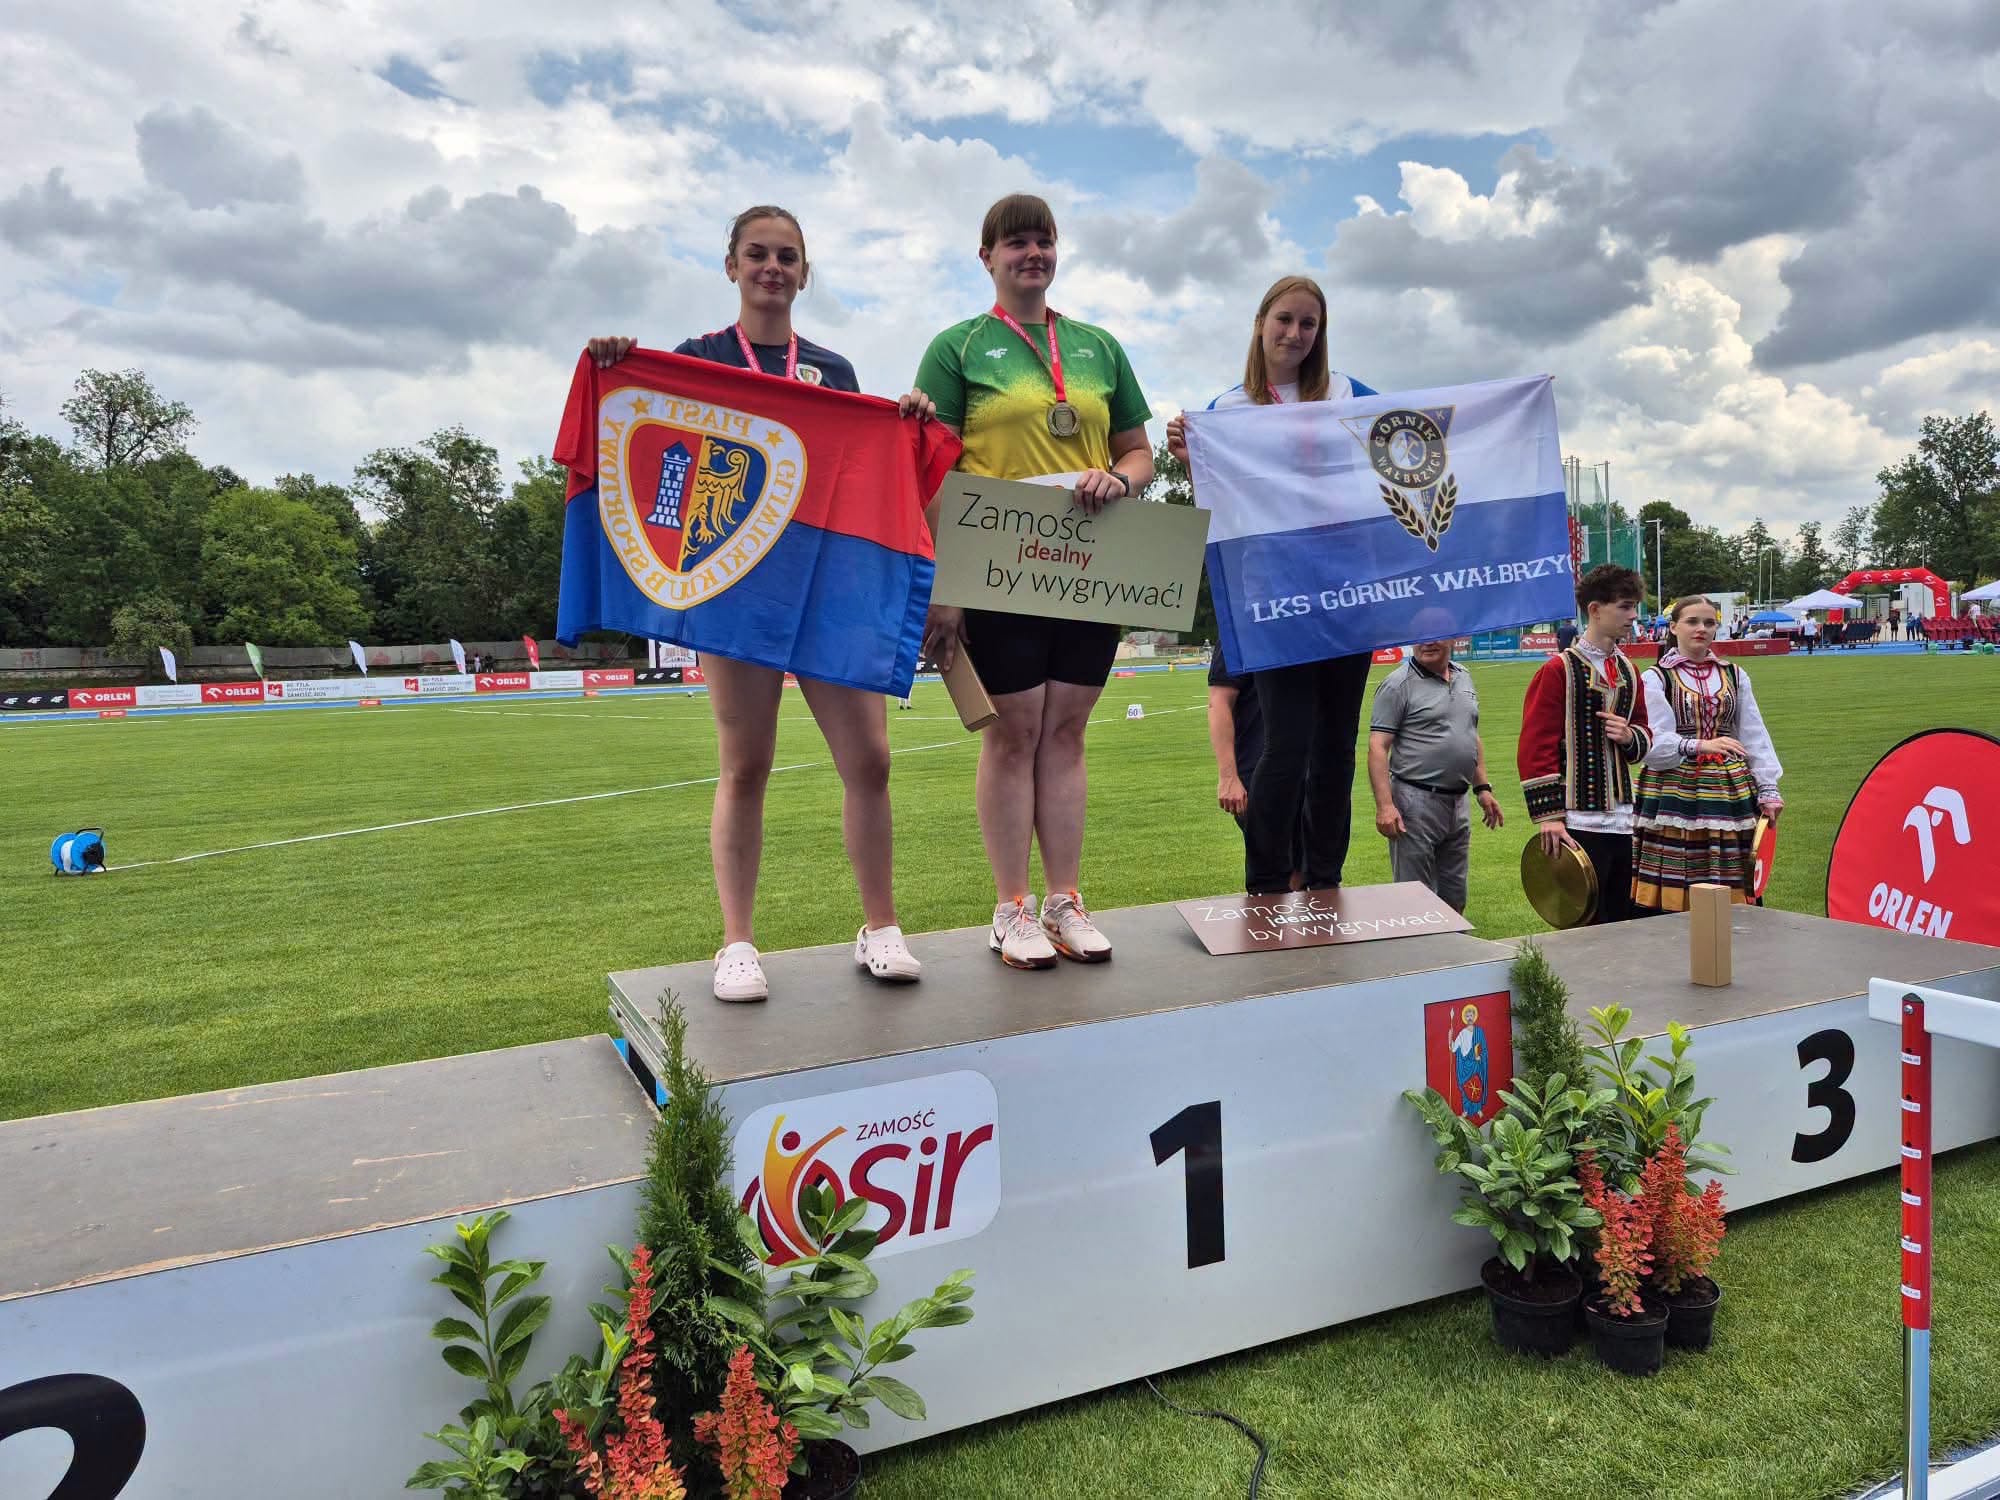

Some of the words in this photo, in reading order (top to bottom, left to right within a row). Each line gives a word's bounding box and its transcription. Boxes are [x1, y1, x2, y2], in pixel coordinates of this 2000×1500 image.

[1375, 415, 1438, 449] GÓRNIK
[1377, 451, 1441, 484] WAŁBRZYCH
[986, 559, 1022, 595] by
[1031, 574, 1184, 609] wygrywać!
[1251, 595, 1311, 623] LKS
[1319, 575, 1425, 611] GÓRNIK
[95, 692, 131, 702] ORLEN
[225, 687, 259, 696] ORLEN
[496, 677, 527, 687] ORLEN
[1128, 708, 1138, 717] 60
[1197, 897, 1334, 921] Zamość.
[1265, 911, 1338, 928] idealny
[1868, 882, 1953, 939] ORLEN
[1248, 928, 1284, 942] by
[1291, 910, 1448, 937] wygrywać!
[1791, 1028, 1856, 1165] 3
[855, 1107, 936, 1141] ZAMOŚĆ
[1149, 1100, 1226, 1270] 1
